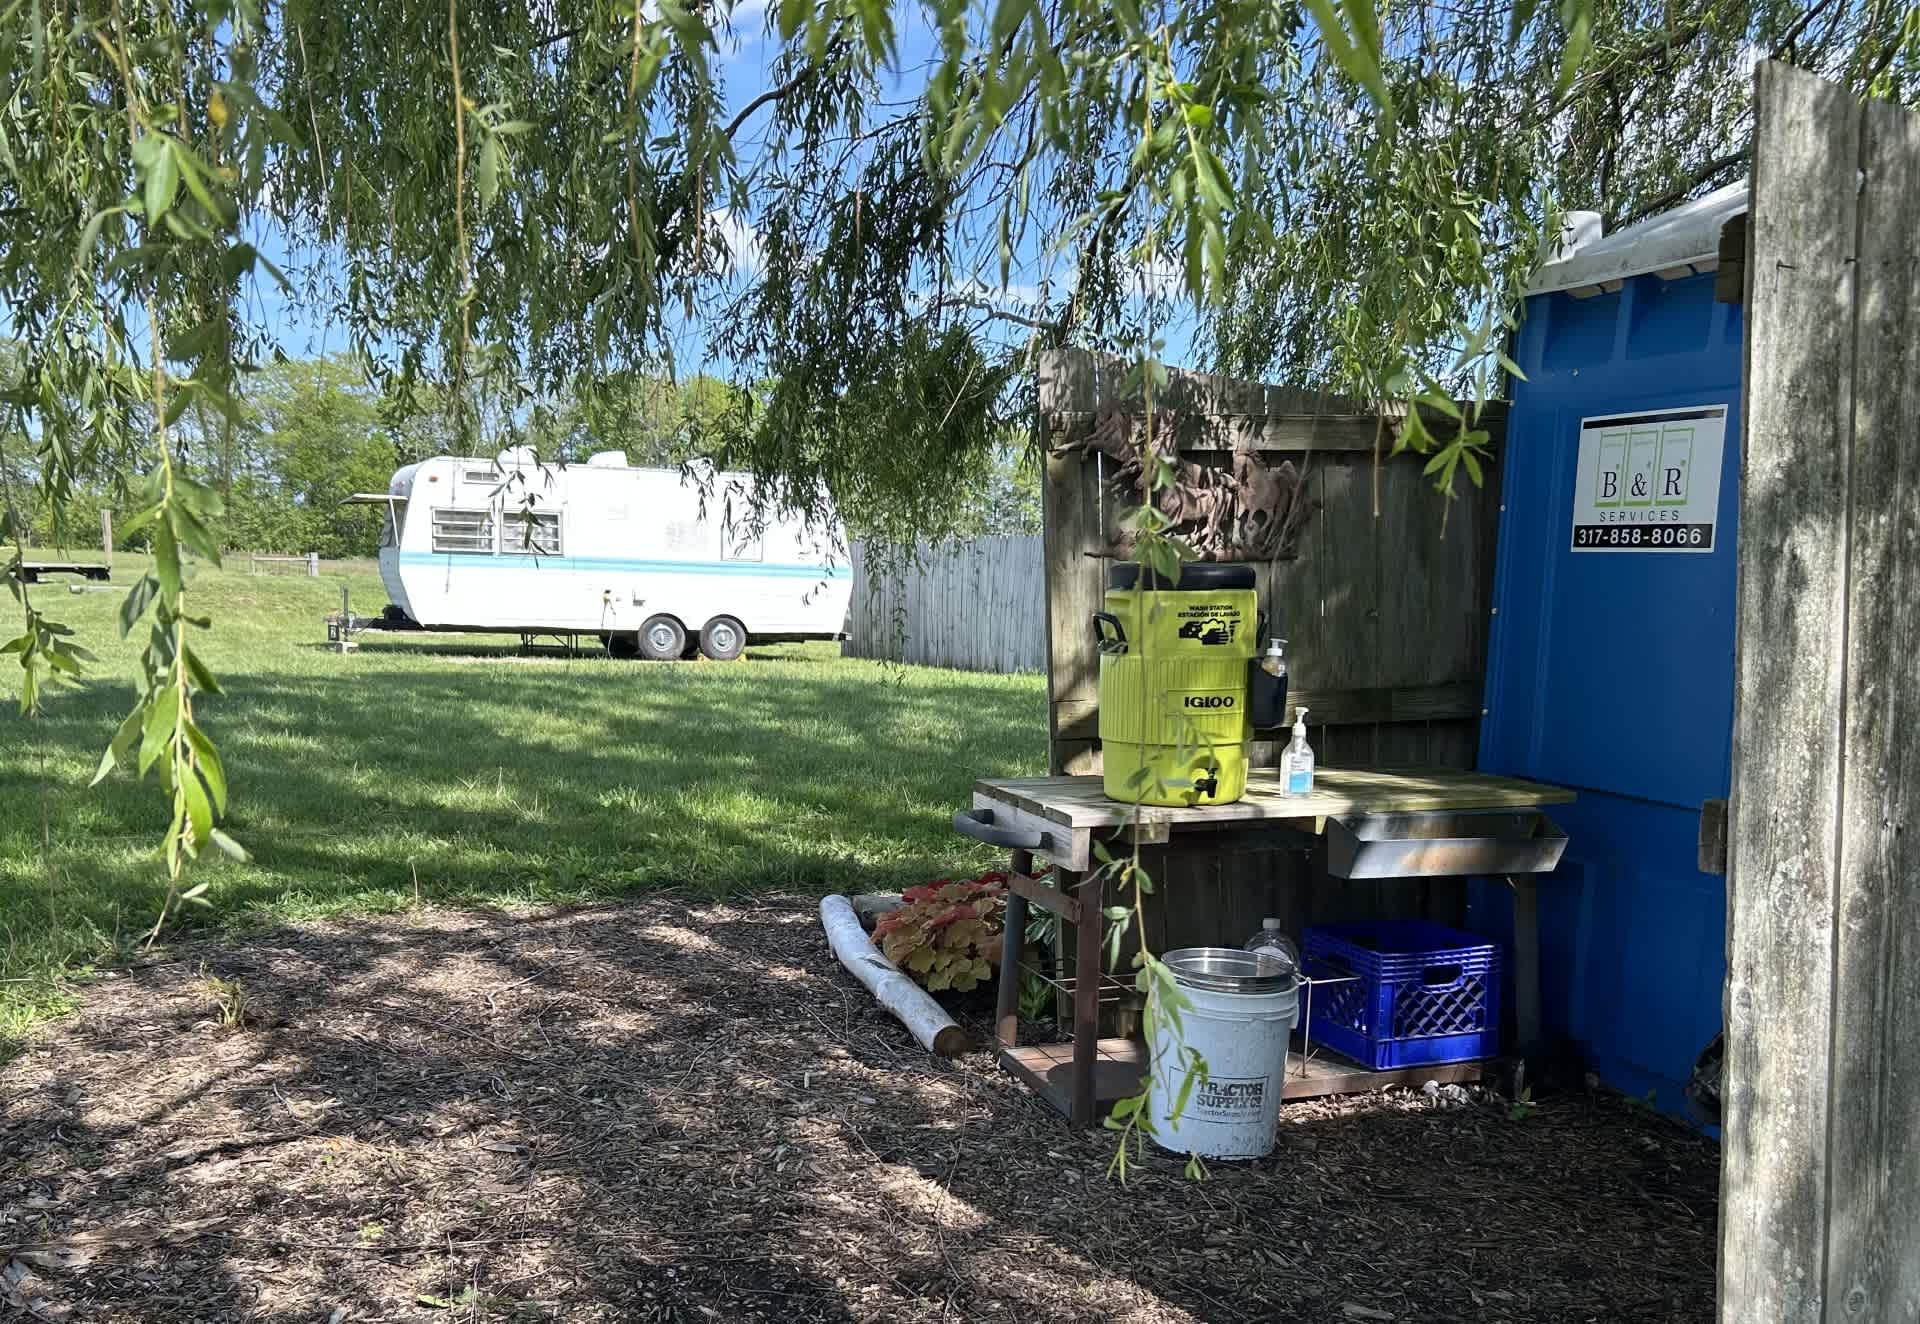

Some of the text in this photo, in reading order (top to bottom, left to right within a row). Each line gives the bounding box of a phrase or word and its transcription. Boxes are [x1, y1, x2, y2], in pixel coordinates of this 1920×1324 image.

[1601, 467, 1682, 498] B & R
[1599, 510, 1680, 522] SERVICES
[1578, 527, 1702, 545] 317-858-8066
[1184, 696, 1235, 709] IGLOO
[1198, 1080, 1264, 1097] TRACTOR
